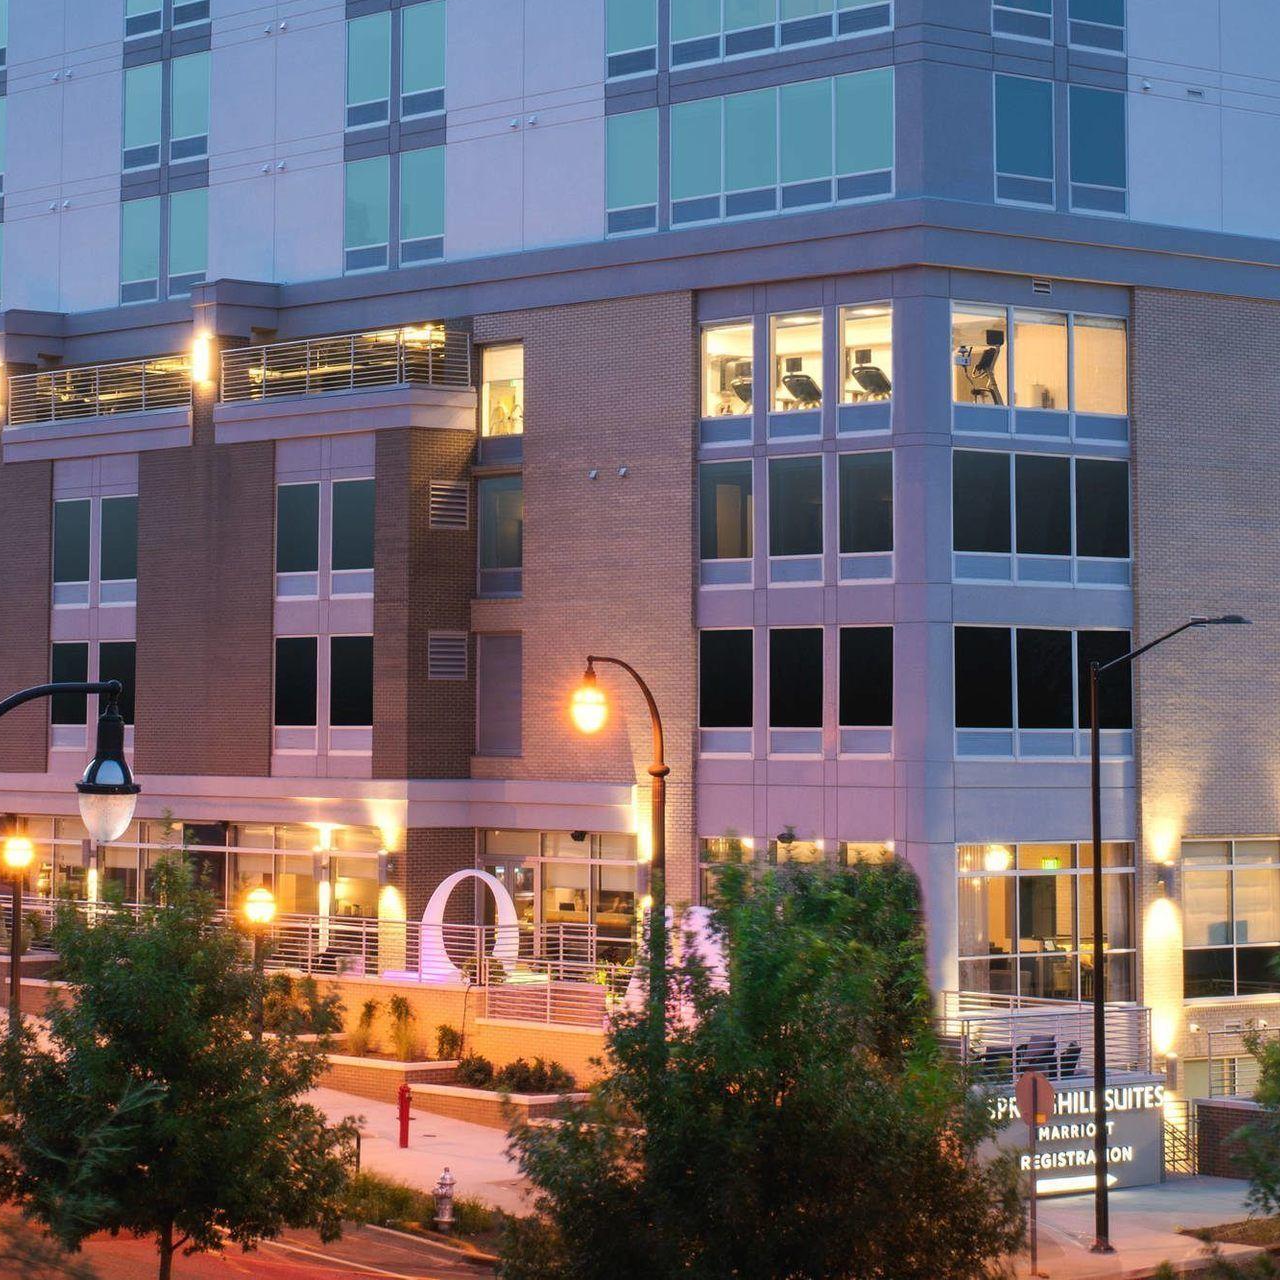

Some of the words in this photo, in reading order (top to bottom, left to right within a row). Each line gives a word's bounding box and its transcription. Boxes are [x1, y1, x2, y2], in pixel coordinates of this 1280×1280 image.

[1104, 1085, 1164, 1111] SUITES
[1039, 1122, 1114, 1141] MARRIOT
[1021, 1146, 1133, 1170] REGISTRAION
